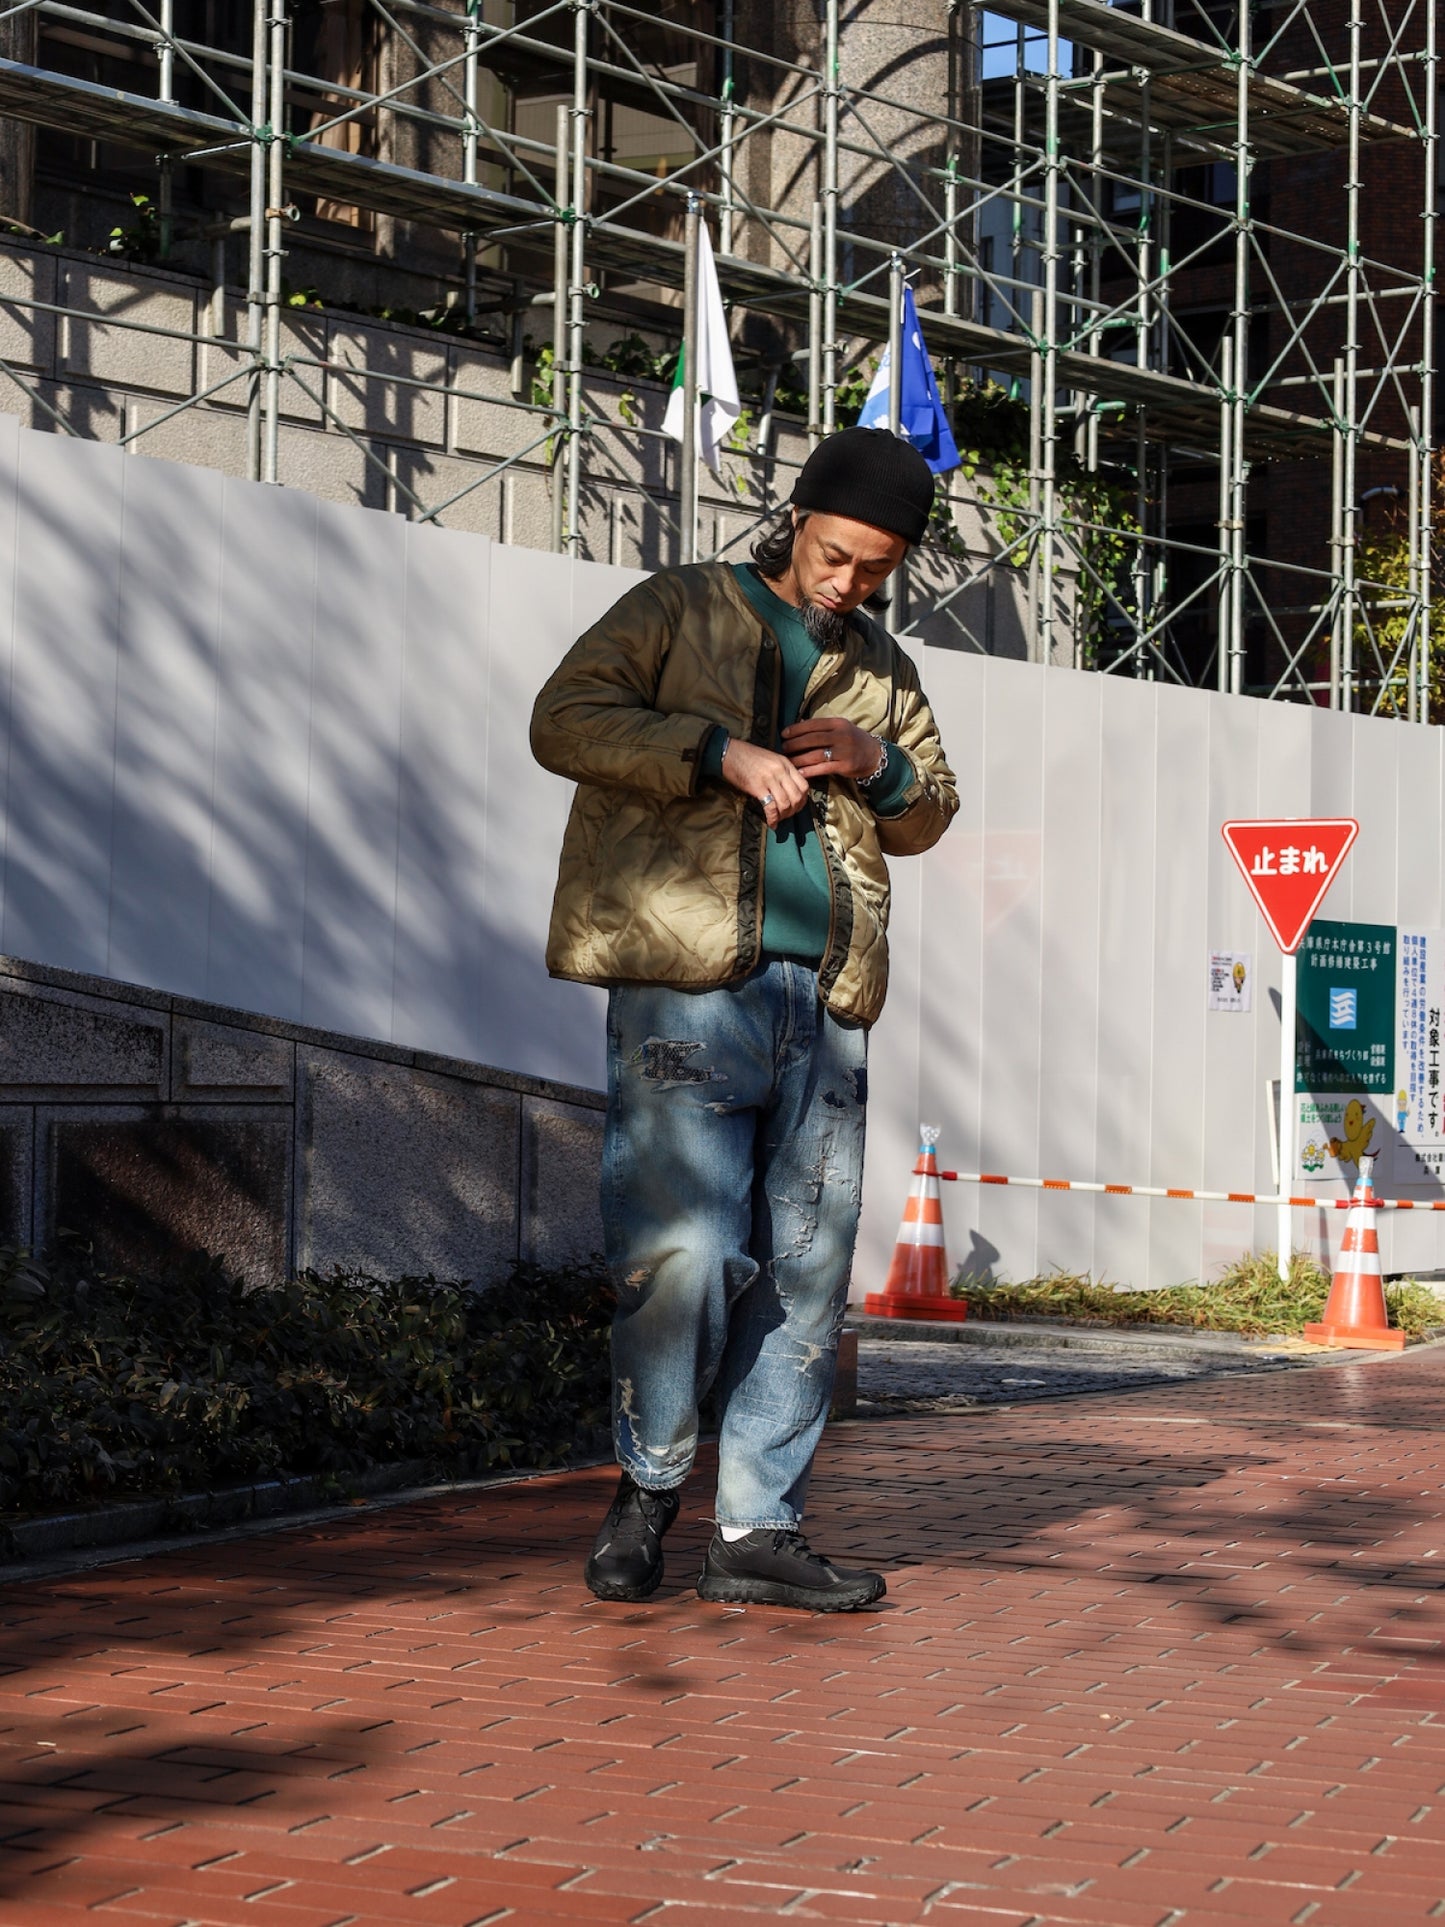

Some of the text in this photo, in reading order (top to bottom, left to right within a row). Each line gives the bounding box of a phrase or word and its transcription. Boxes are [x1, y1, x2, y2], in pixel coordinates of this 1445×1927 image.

[1251, 845, 1328, 875] 止まれ
[1428, 1007, 1440, 1137] 対象工事です。
